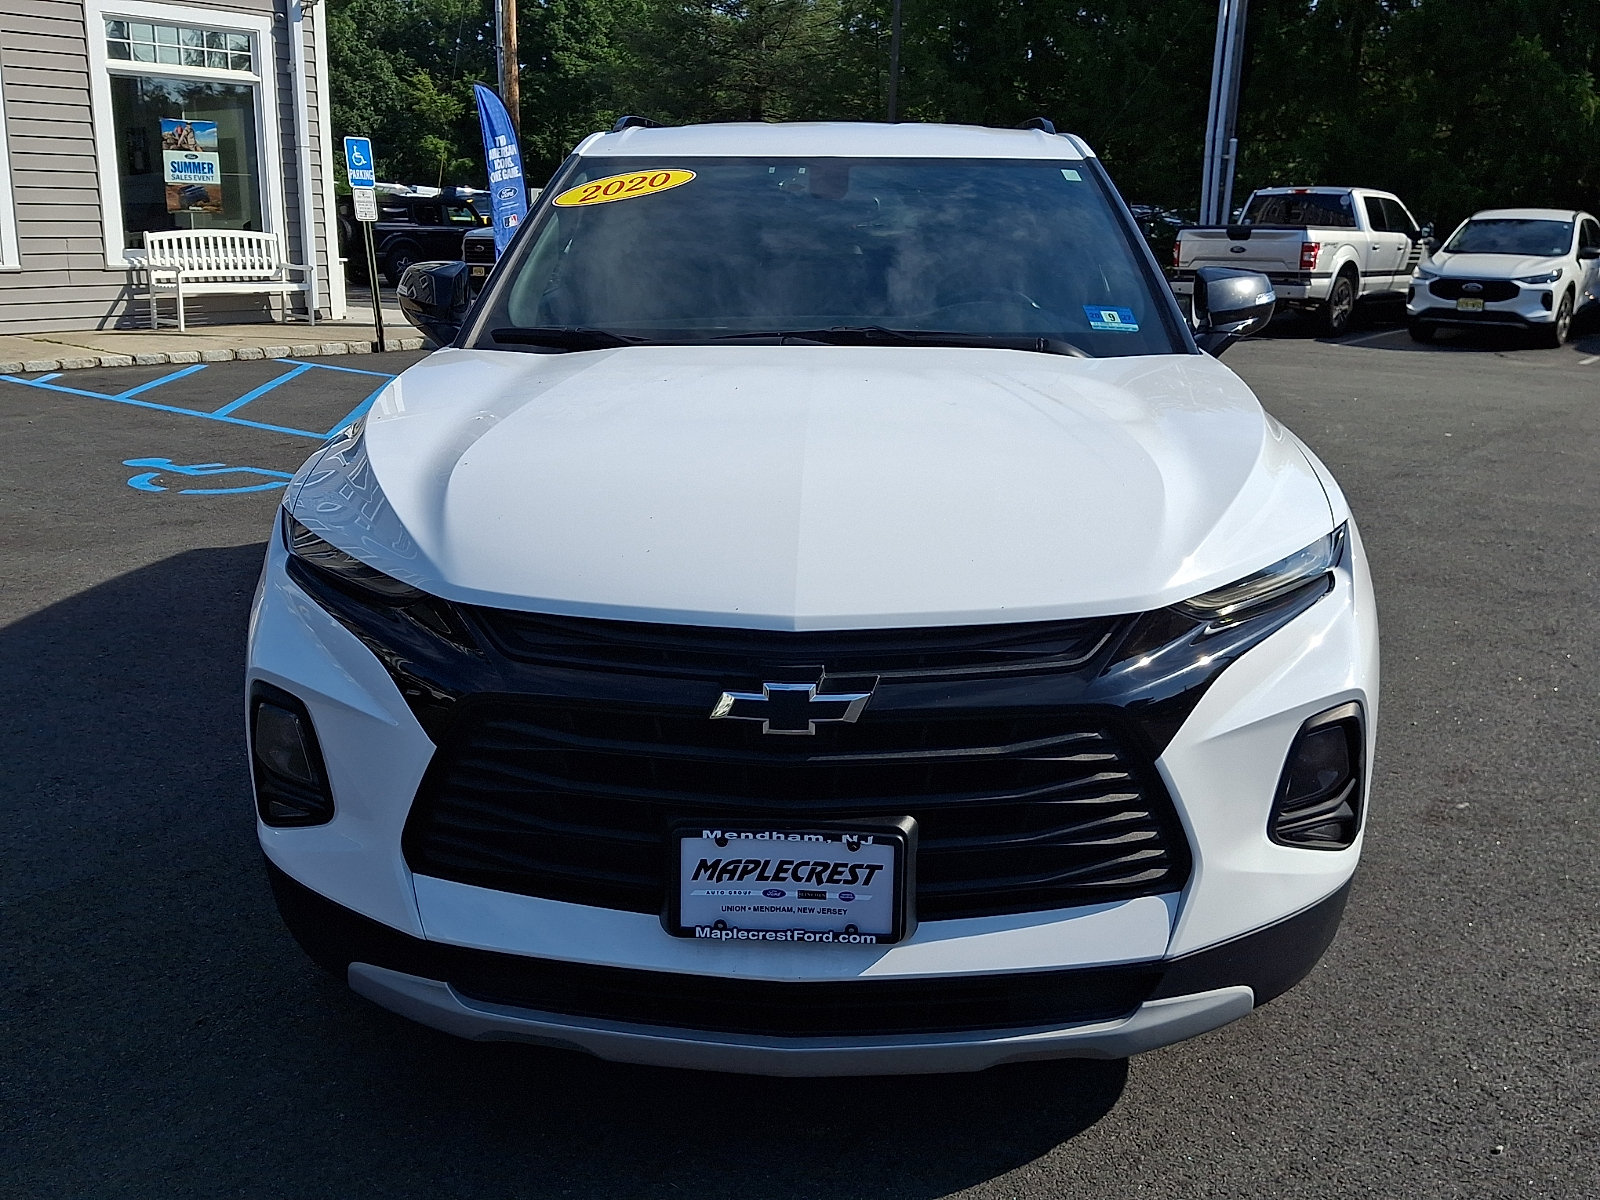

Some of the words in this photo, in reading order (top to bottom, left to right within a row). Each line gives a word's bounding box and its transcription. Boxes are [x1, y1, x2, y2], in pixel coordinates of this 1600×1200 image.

[170, 160, 214, 175] SUMMER
[349, 169, 374, 180] PARKING
[500, 188, 515, 199] Ford
[578, 172, 671, 203] 2020
[1107, 313, 1116, 322] 9
[702, 830, 832, 844] Mendham,
[841, 834, 874, 845] NJ
[691, 858, 884, 887] MAPLECREST
[752, 905, 796, 914] MENDHAM,
[816, 907, 848, 916] JERSEY
[695, 926, 877, 944] MaplecrestFord.com
